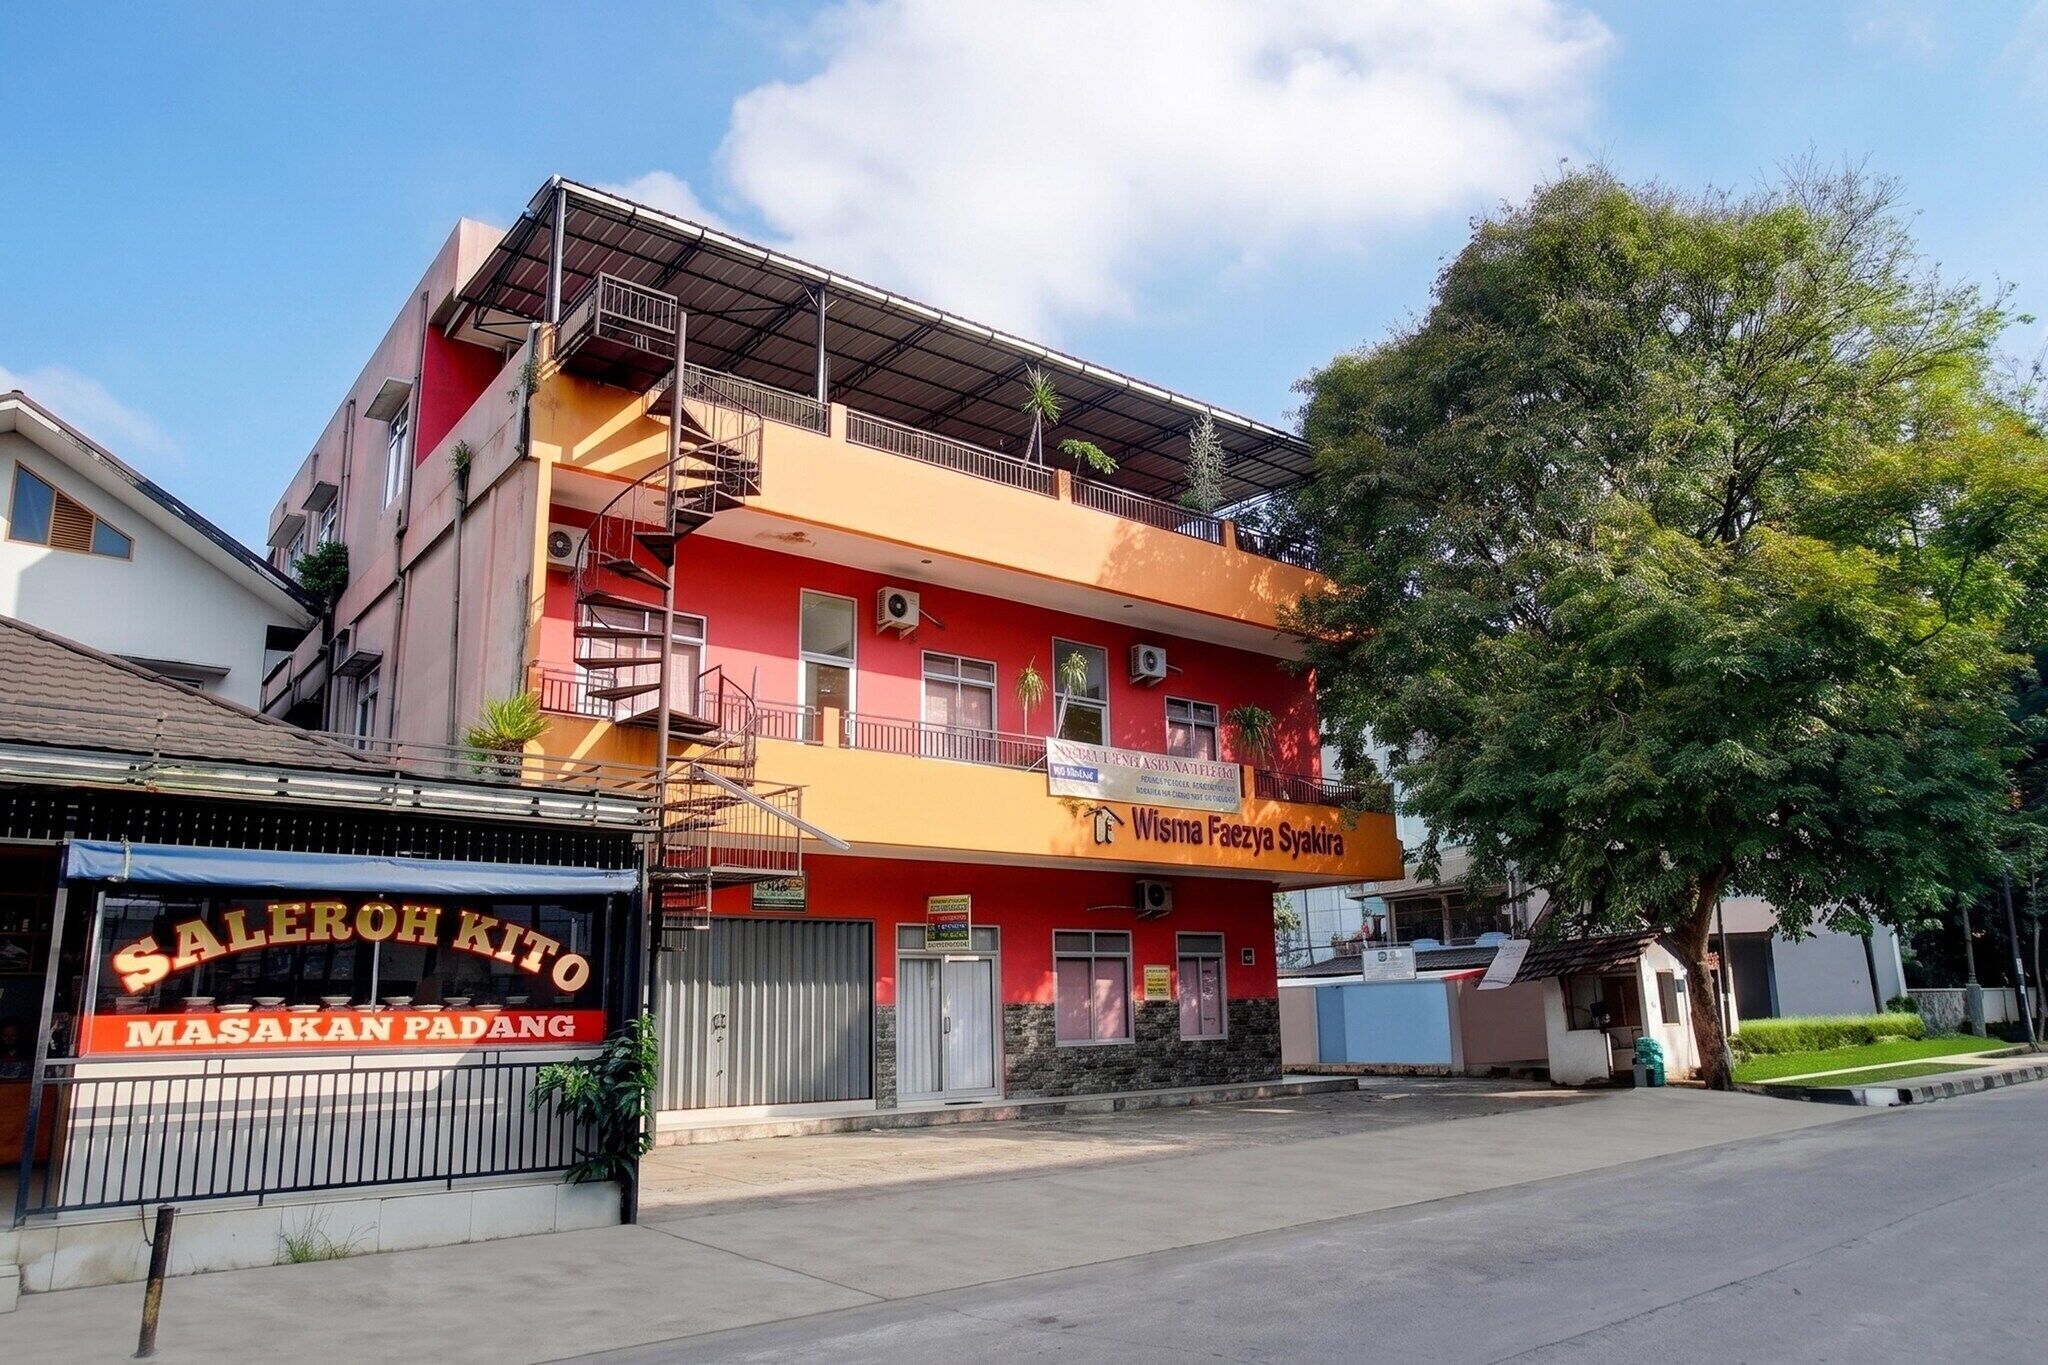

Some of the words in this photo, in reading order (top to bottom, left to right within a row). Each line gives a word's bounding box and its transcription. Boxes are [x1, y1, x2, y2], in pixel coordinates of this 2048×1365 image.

[1132, 806, 1202, 844] Wisma
[1208, 815, 1274, 857] Faezya
[1278, 821, 1344, 859] Syakira
[112, 901, 441, 994] SALEROH
[451, 909, 591, 993] KITO
[124, 1016, 391, 1048] MASAKAN
[403, 1014, 577, 1041] PADANG
